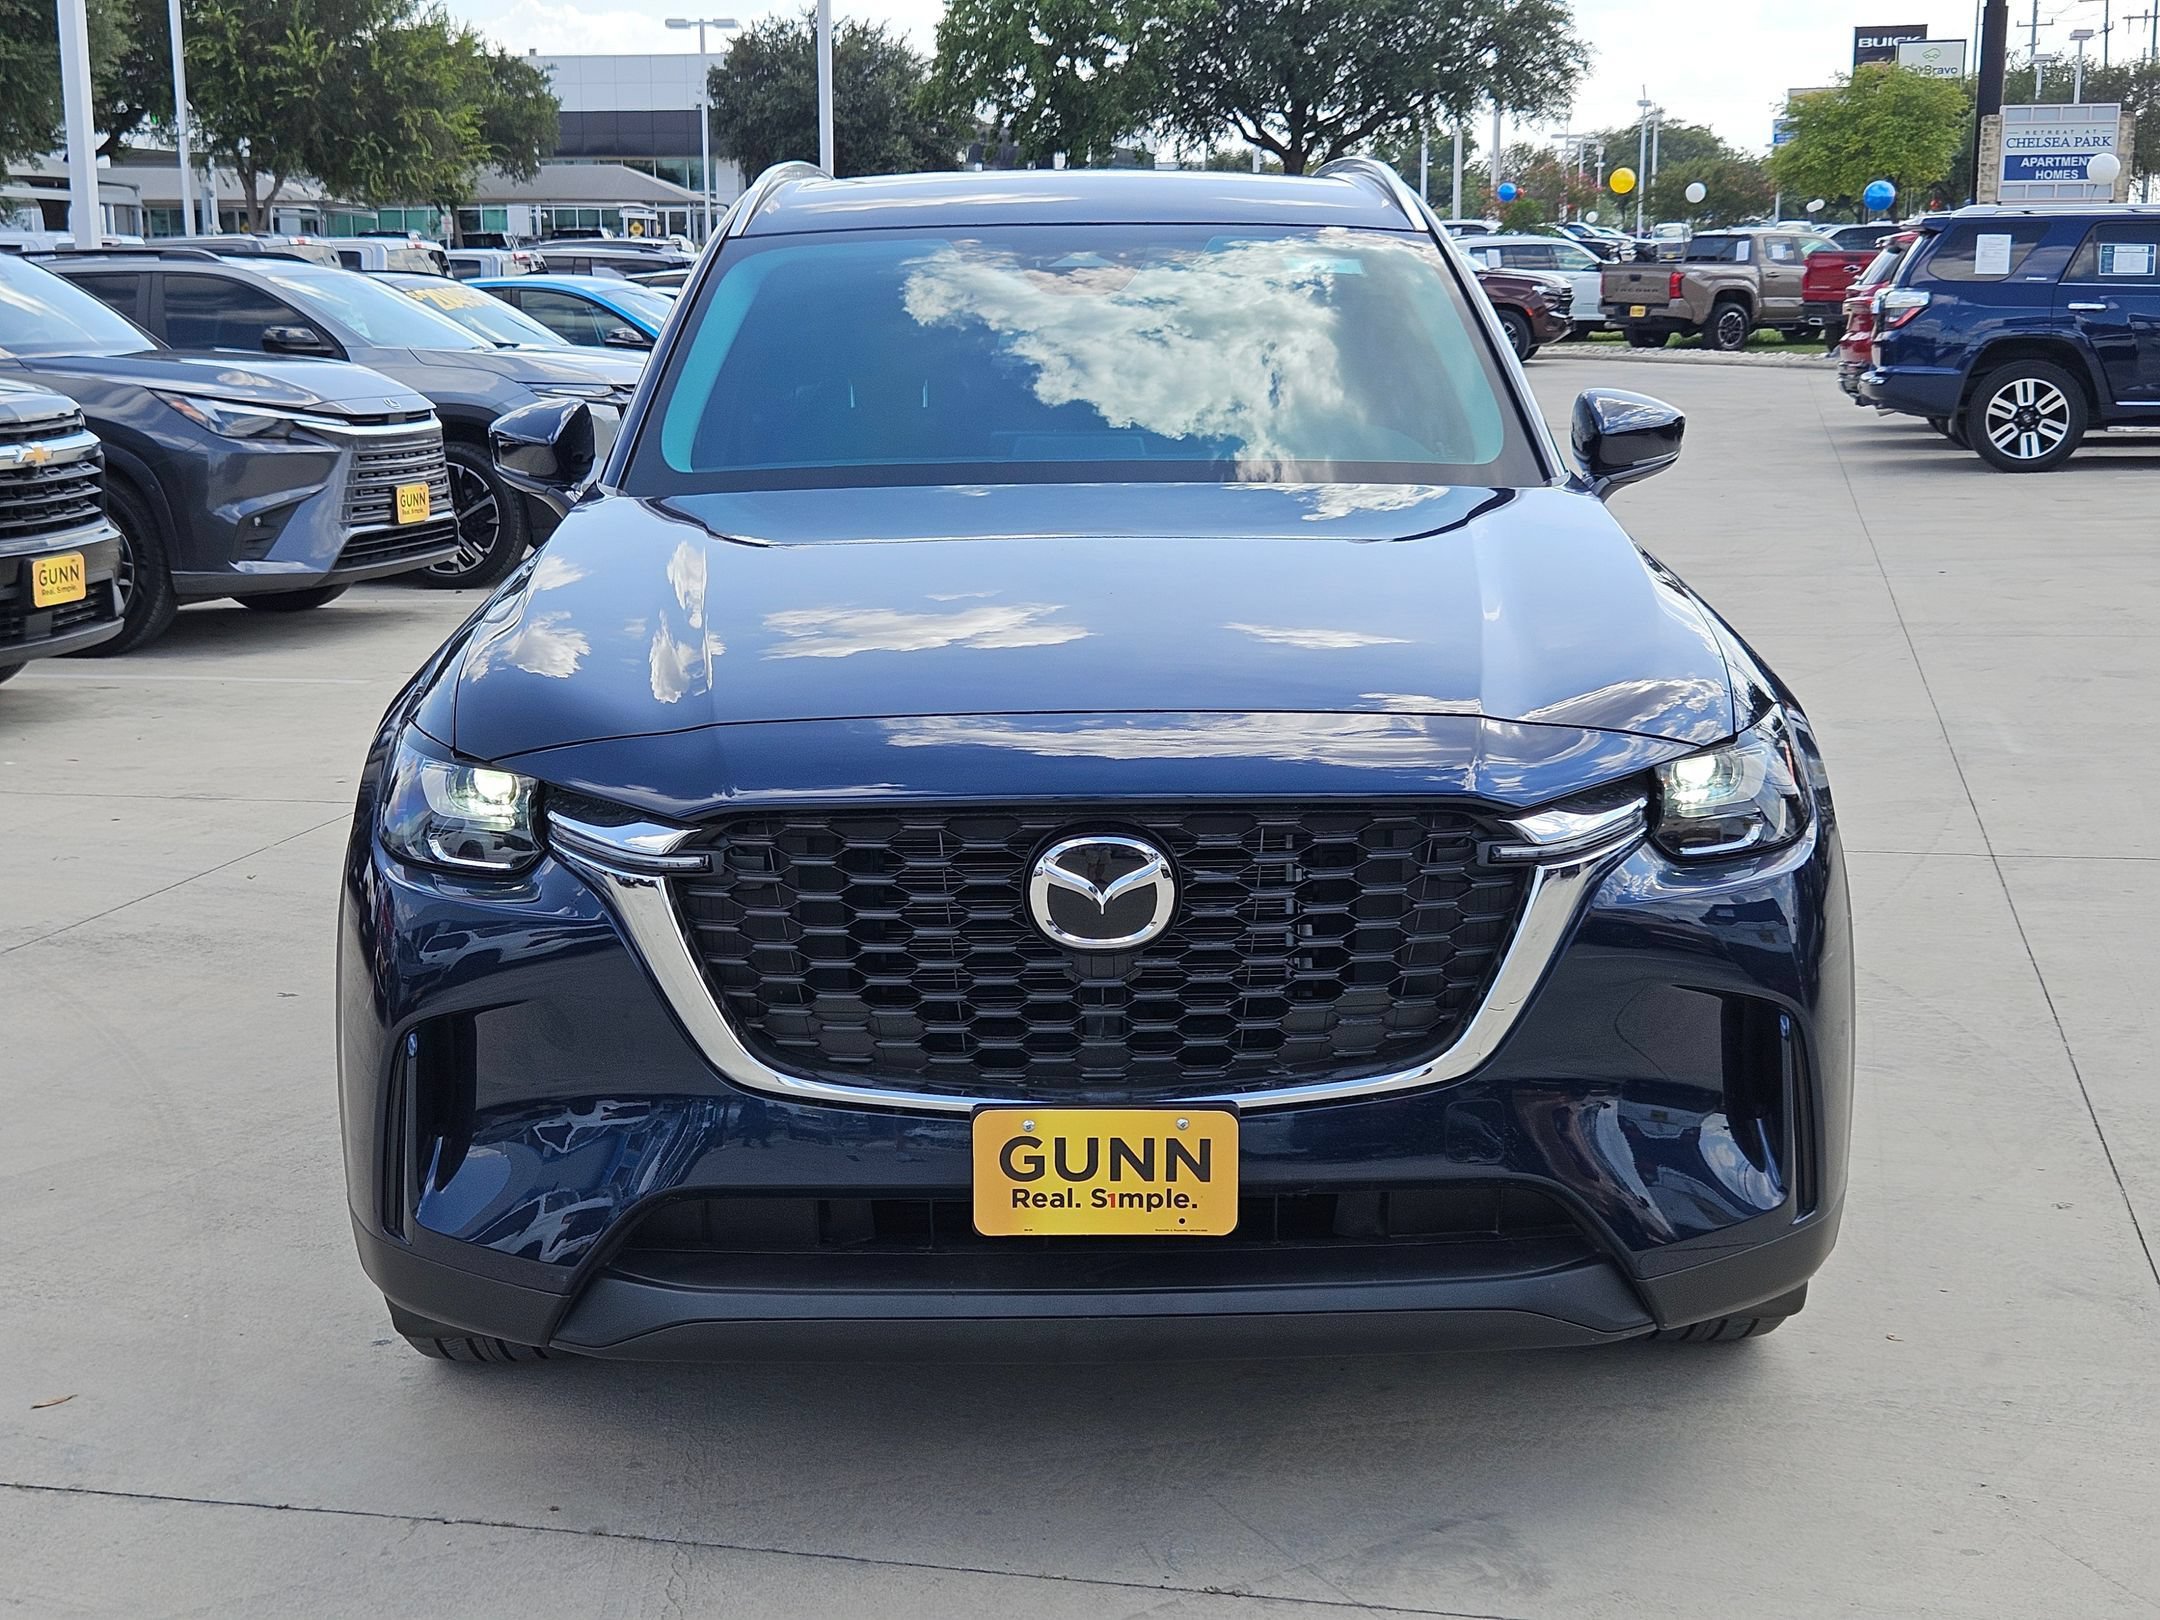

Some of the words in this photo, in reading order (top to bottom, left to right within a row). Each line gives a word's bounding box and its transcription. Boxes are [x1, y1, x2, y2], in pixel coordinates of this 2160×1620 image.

[2006, 136, 2071, 149] CHELSEA
[2073, 135, 2113, 147] PARK
[2020, 156, 2093, 167] APARTMEN
[2035, 169, 2079, 180] HOMES
[400, 492, 426, 507] GUNN
[39, 564, 80, 587] GUNN
[999, 1135, 1212, 1183] GUNN
[1011, 1187, 1082, 1210] Real.
